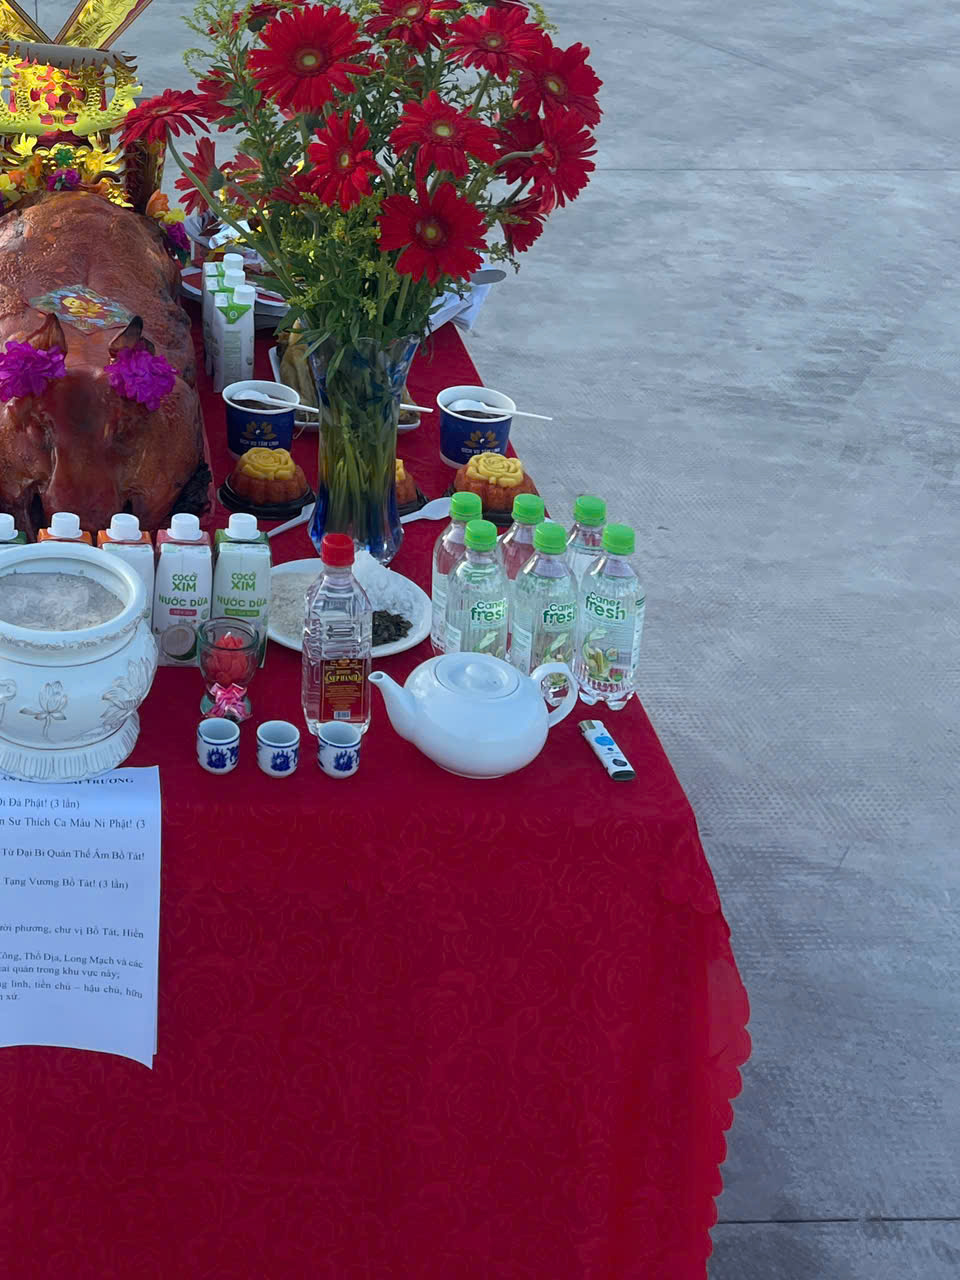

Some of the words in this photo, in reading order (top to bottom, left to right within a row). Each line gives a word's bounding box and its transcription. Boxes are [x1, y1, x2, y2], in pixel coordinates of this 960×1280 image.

[172, 582, 197, 592] XIM
[231, 581, 256, 592] XIM
[585, 596, 626, 620] fresh
[50, 799, 60, 809] (3
[53, 818, 66, 827] Ca
[94, 819, 105, 828] Ni
[136, 819, 145, 829] (3
[34, 848, 45, 857] Bi
[98, 880, 108, 890] (3
[64, 954, 87, 965] Long
[36, 966, 60, 976] trong
[62, 967, 79, 976] khu
[11, 980, 31, 989] linh,
